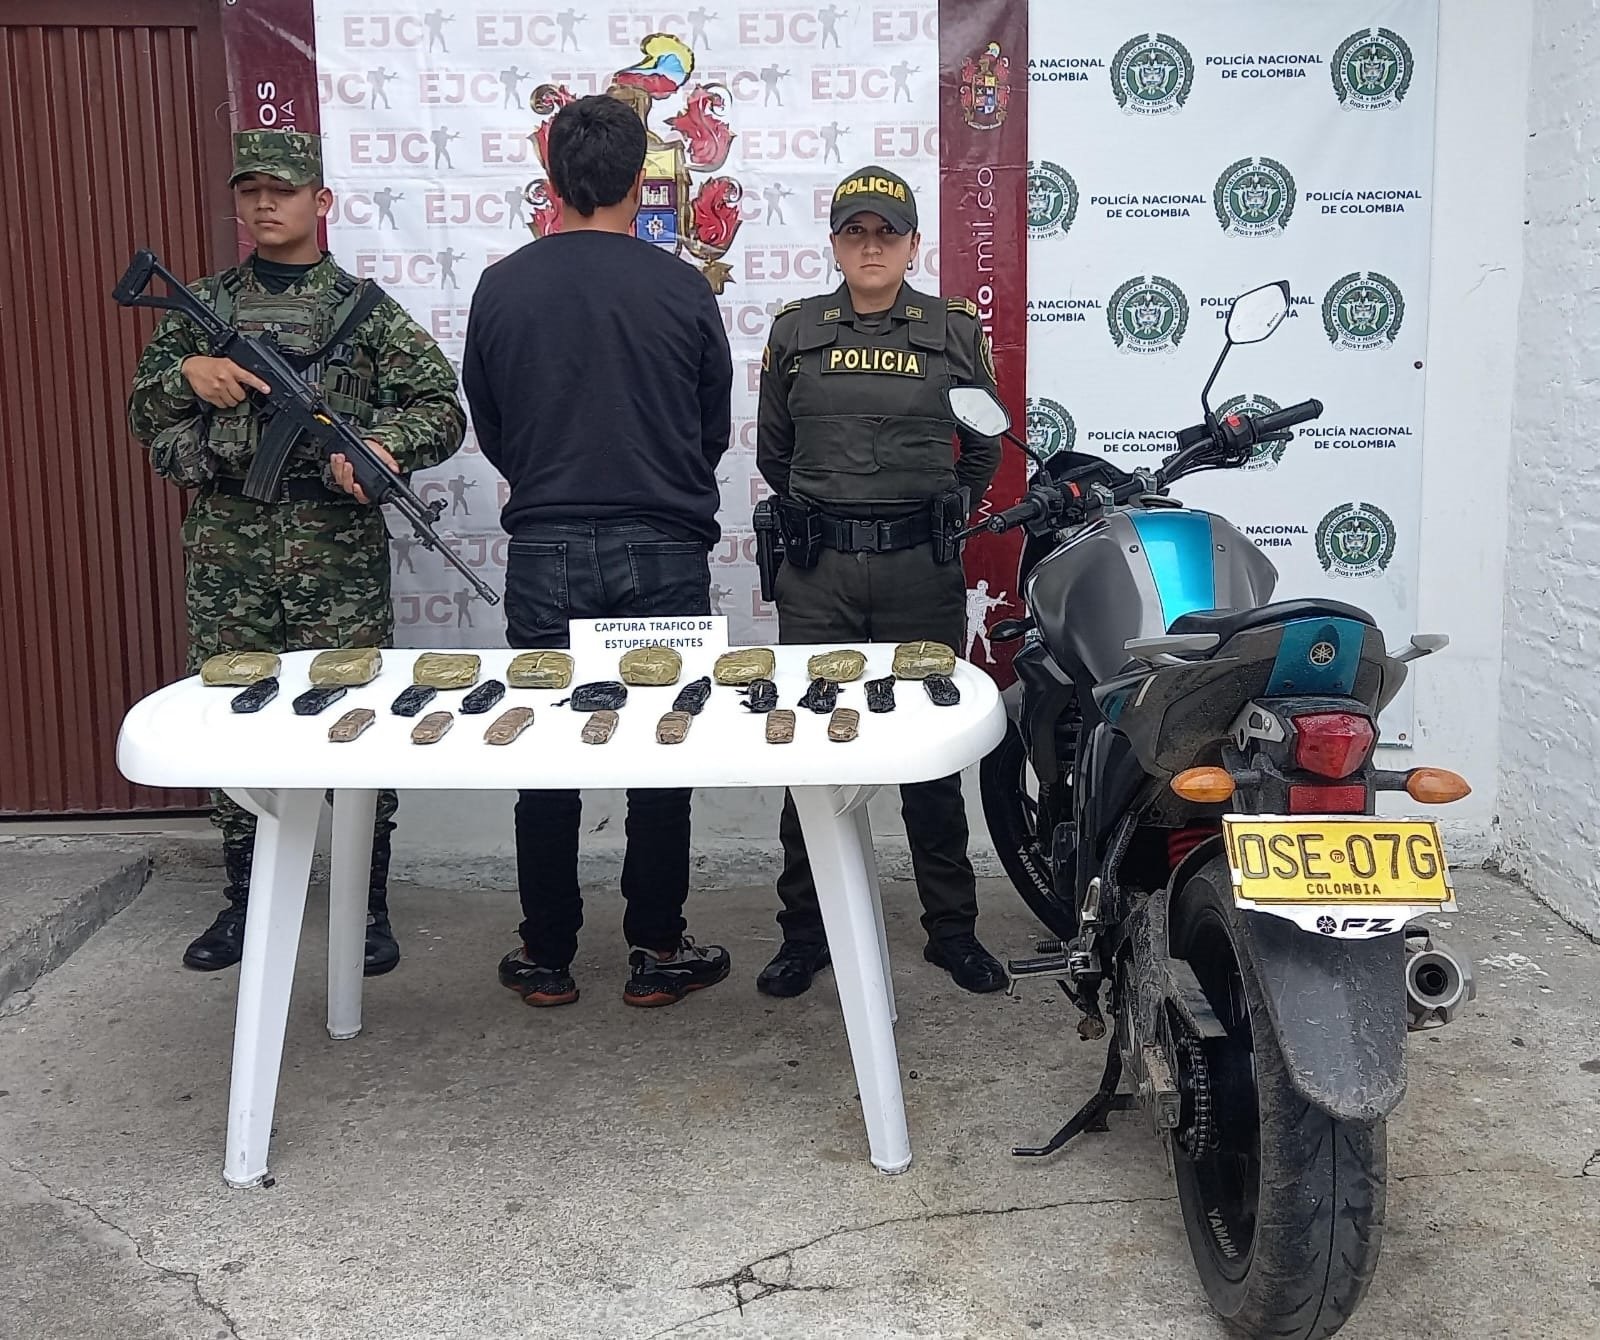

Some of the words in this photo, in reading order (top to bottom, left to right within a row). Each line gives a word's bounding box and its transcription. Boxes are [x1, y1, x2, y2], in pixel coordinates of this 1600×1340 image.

[343, 16, 424, 48] EJC
[476, 15, 556, 47] EJC
[608, 14, 687, 46] EJC
[738, 13, 818, 45] EJC
[1040, 58, 1105, 68] NACIONAL
[1206, 54, 1254, 66] POLICÍA
[1258, 54, 1323, 65] NACIONAL
[811, 69, 890, 100] EJC
[1222, 70, 1237, 79] DE
[1243, 69, 1306, 78] COLOMBIA
[319, 73, 366, 104] JC
[419, 73, 499, 104] EJC
[257, 81, 276, 126] OS
[350, 133, 429, 163] EJC
[481, 133, 528, 163] EJ
[741, 129, 819, 160] EJC
[835, 177, 907, 202] POLICIA
[1091, 194, 1138, 205] POLICÍA
[1142, 195, 1206, 205] NACIONAL
[1306, 190, 1353, 201] POLICÍA
[1357, 190, 1422, 201] NACIONAL
[328, 194, 372, 224] JC
[425, 194, 504, 224] EJC
[1106, 209, 1122, 218] DE
[1126, 208, 1190, 218] COLOMBIA
[1321, 205, 1337, 214] DE
[1340, 204, 1404, 214] COLOMBIA
[356, 254, 436, 284] EJC
[745, 250, 822, 280] EJC
[1039, 300, 1102, 309] NACIONAL
[1201, 297, 1236, 306] POLIC
[719, 306, 765, 335] JC
[830, 350, 920, 374] POLICIA
[1088, 429, 1135, 440] POLICÍA
[1139, 430, 1176, 439] NACIO
[1299, 426, 1346, 437] POLICÍA
[1350, 426, 1412, 436] NACIONAL
[1104, 444, 1119, 453] DE
[1314, 440, 1330, 449] DE
[1333, 440, 1396, 449] COLOMBIA
[1246, 525, 1309, 535] NACIONAL
[1254, 538, 1292, 547] OMBIA
[400, 595, 453, 624] JC
[594, 622, 646, 632] CAPTURA
[649, 621, 695, 631] TRAFICO
[698, 620, 713, 630] DE
[605, 637, 703, 649] ESTUPEFACIENTES
[1017, 846, 1050, 896] YAMAHA
[1306, 883, 1382, 895] COLOMBIA
[1341, 918, 1395, 932] FZ
[1208, 1208, 1239, 1259] YAMAHA
